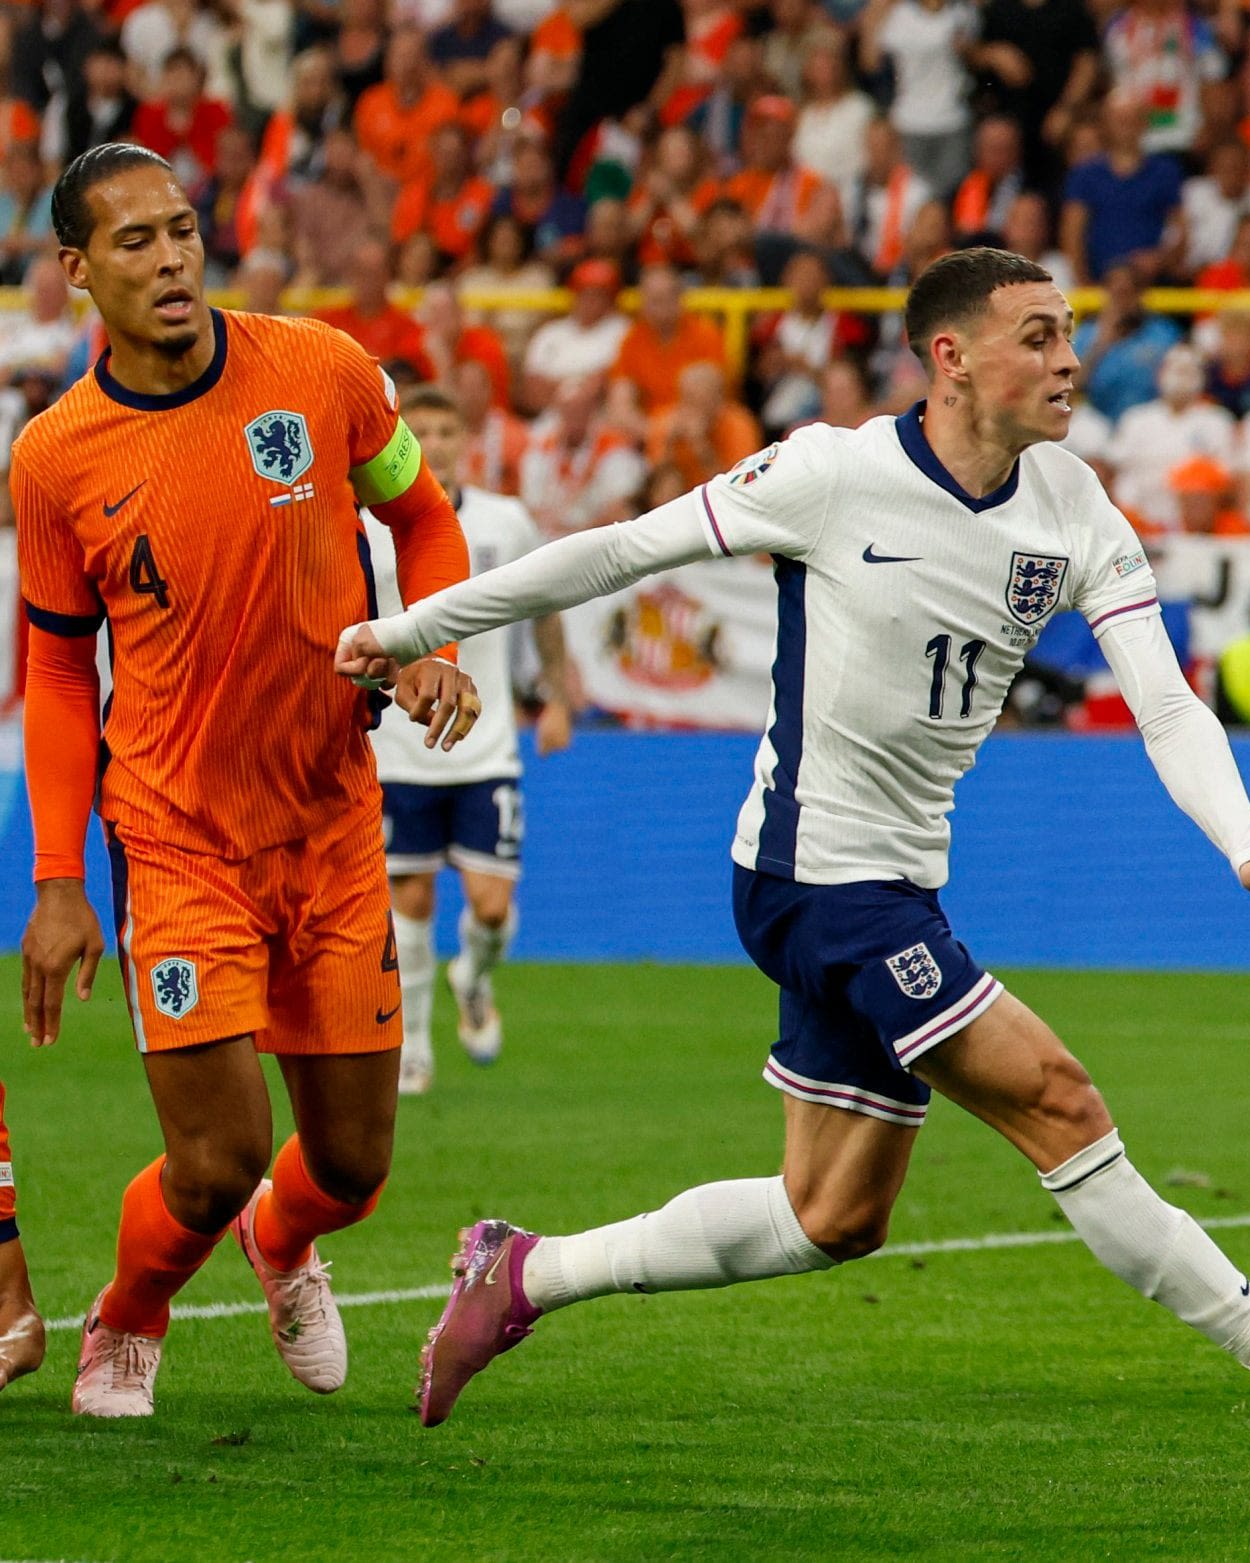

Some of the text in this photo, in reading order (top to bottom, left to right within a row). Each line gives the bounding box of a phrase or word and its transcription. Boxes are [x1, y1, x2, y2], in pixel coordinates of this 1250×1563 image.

[129, 534, 170, 609] 4
[925, 634, 986, 719] 11
[382, 908, 401, 987] 4
